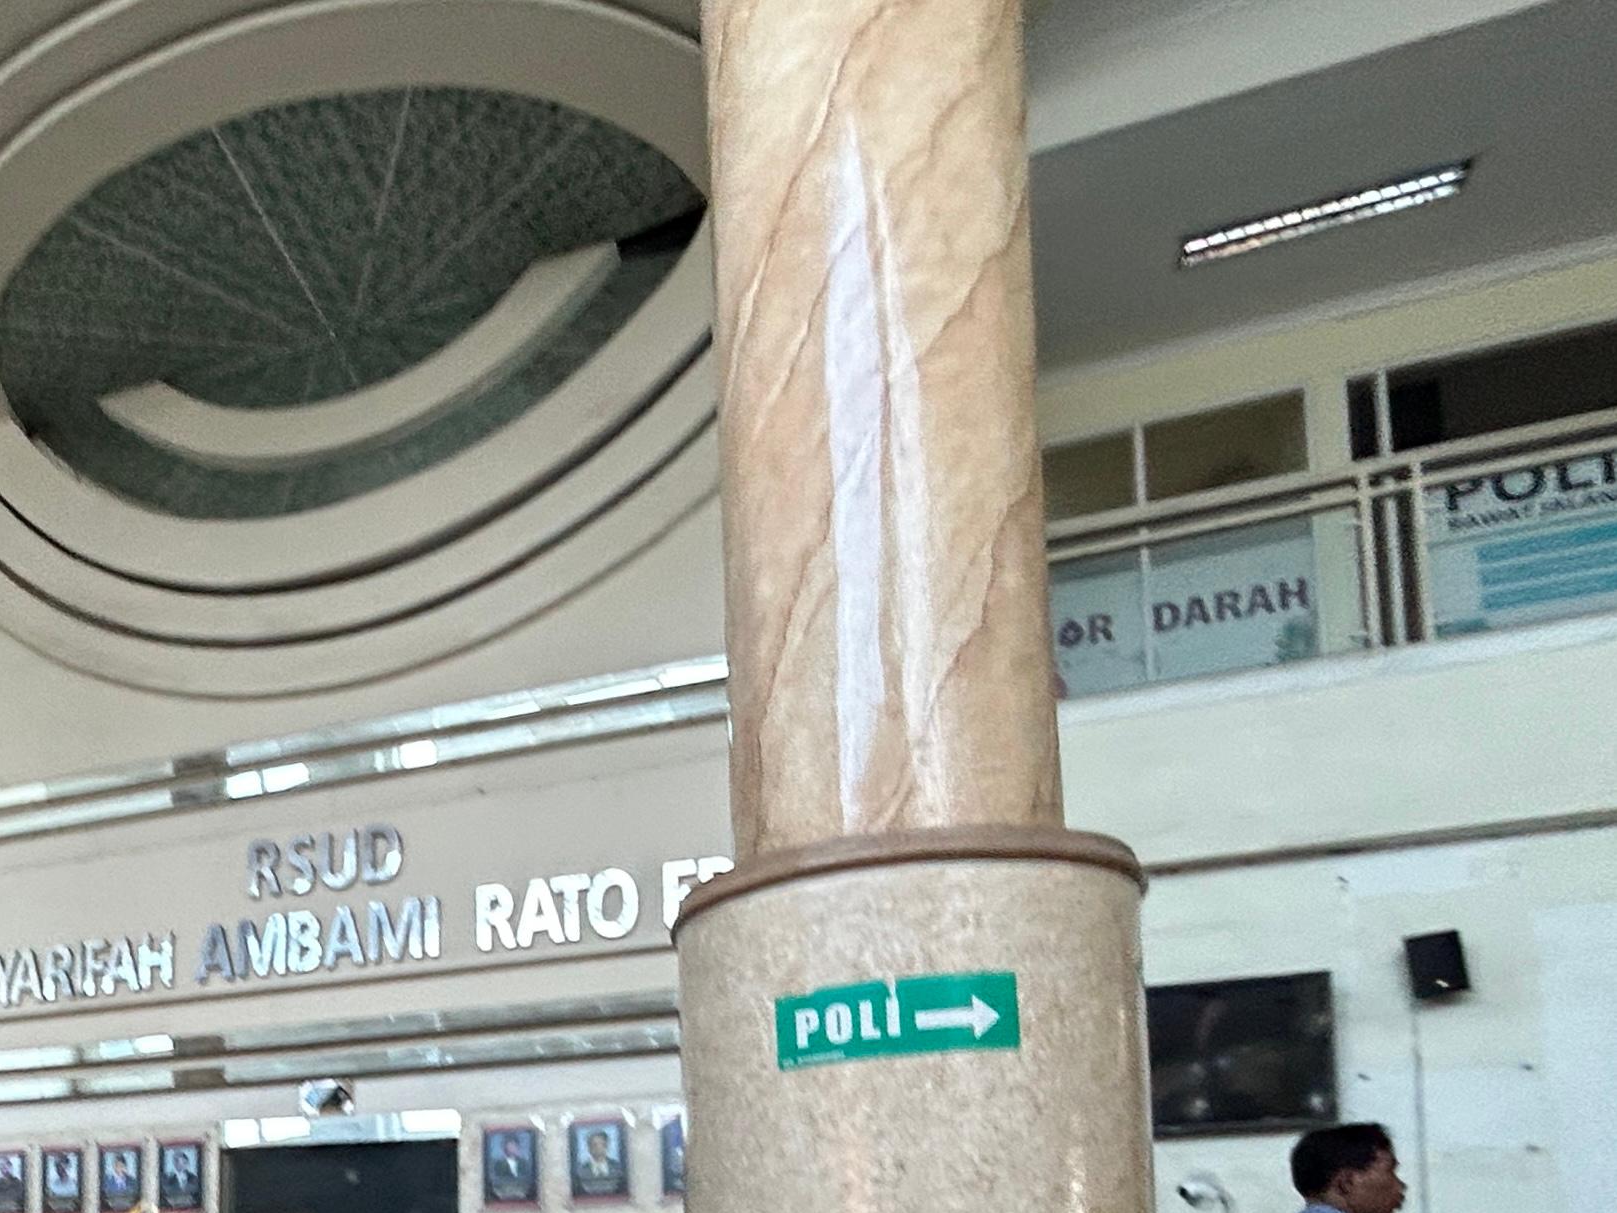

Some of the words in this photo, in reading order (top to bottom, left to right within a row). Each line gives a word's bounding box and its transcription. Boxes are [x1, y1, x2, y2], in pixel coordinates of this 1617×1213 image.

[1152, 576, 1310, 634] DARAH
[247, 822, 405, 900] RSUD
[193, 895, 444, 986] AMBAMI
[474, 866, 641, 953] RATO
[794, 998, 902, 1050] POLI
